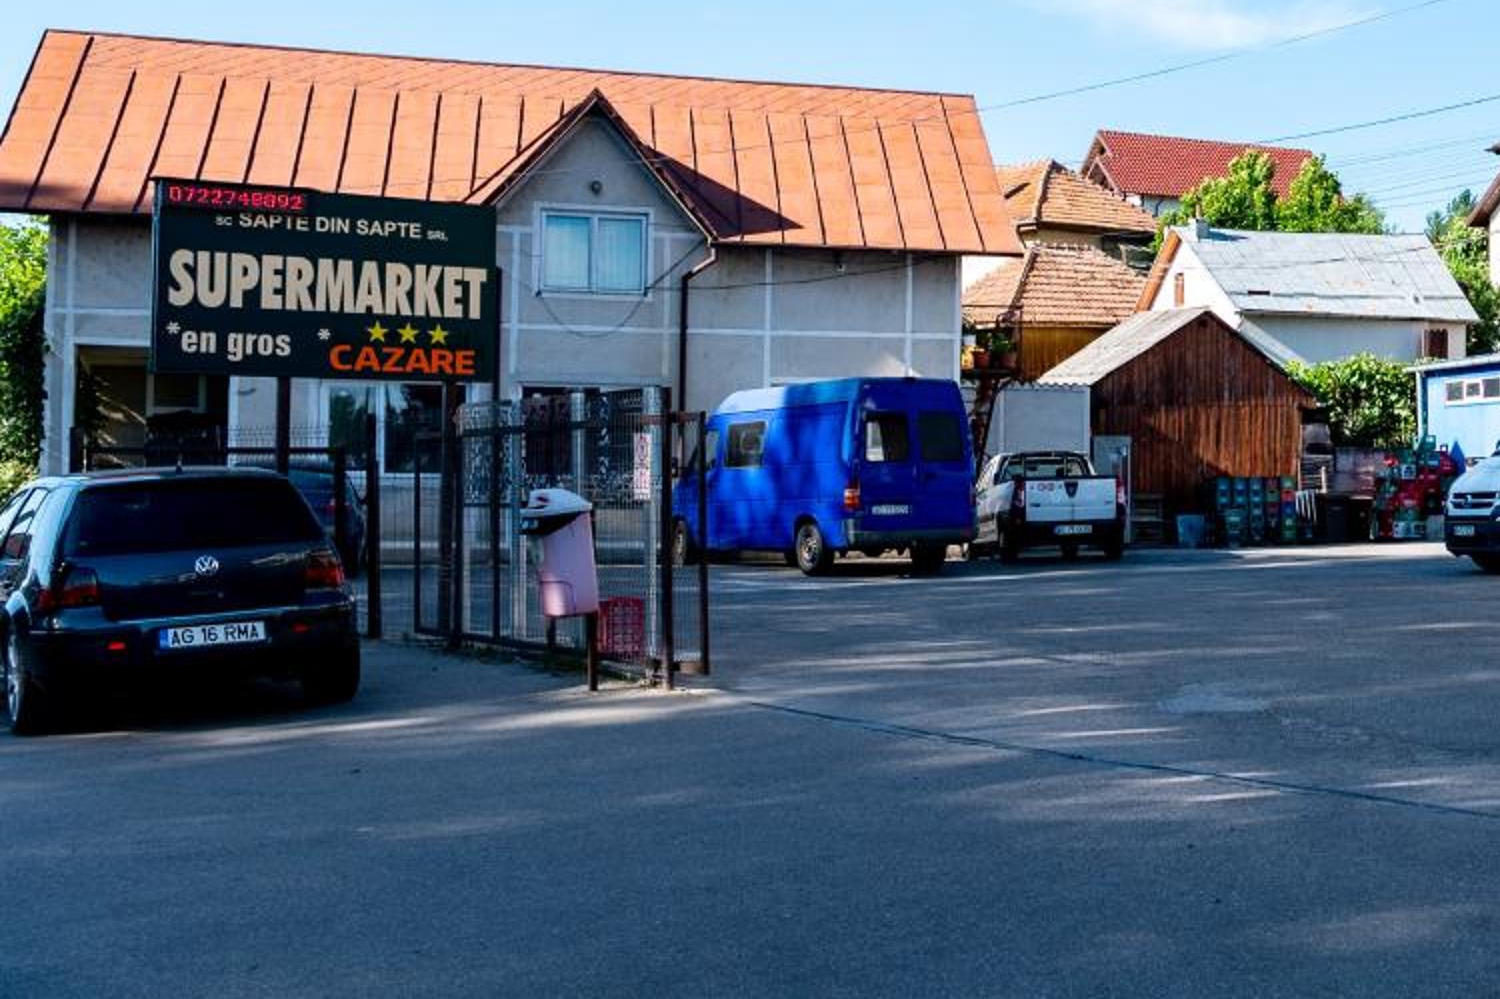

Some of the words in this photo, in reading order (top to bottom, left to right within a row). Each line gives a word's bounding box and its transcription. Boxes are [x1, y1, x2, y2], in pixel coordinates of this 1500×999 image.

[239, 212, 310, 232] SAPTE
[315, 216, 350, 234] DIN
[356, 219, 422, 239] SAPTE
[427, 230, 449, 242] SRL
[167, 248, 488, 321] SUPERMARKET
[227, 332, 291, 362] gros
[329, 344, 476, 376] CAZARE
[171, 628, 195, 646] AG
[201, 626, 219, 642] 16
[224, 624, 260, 641] RMA
